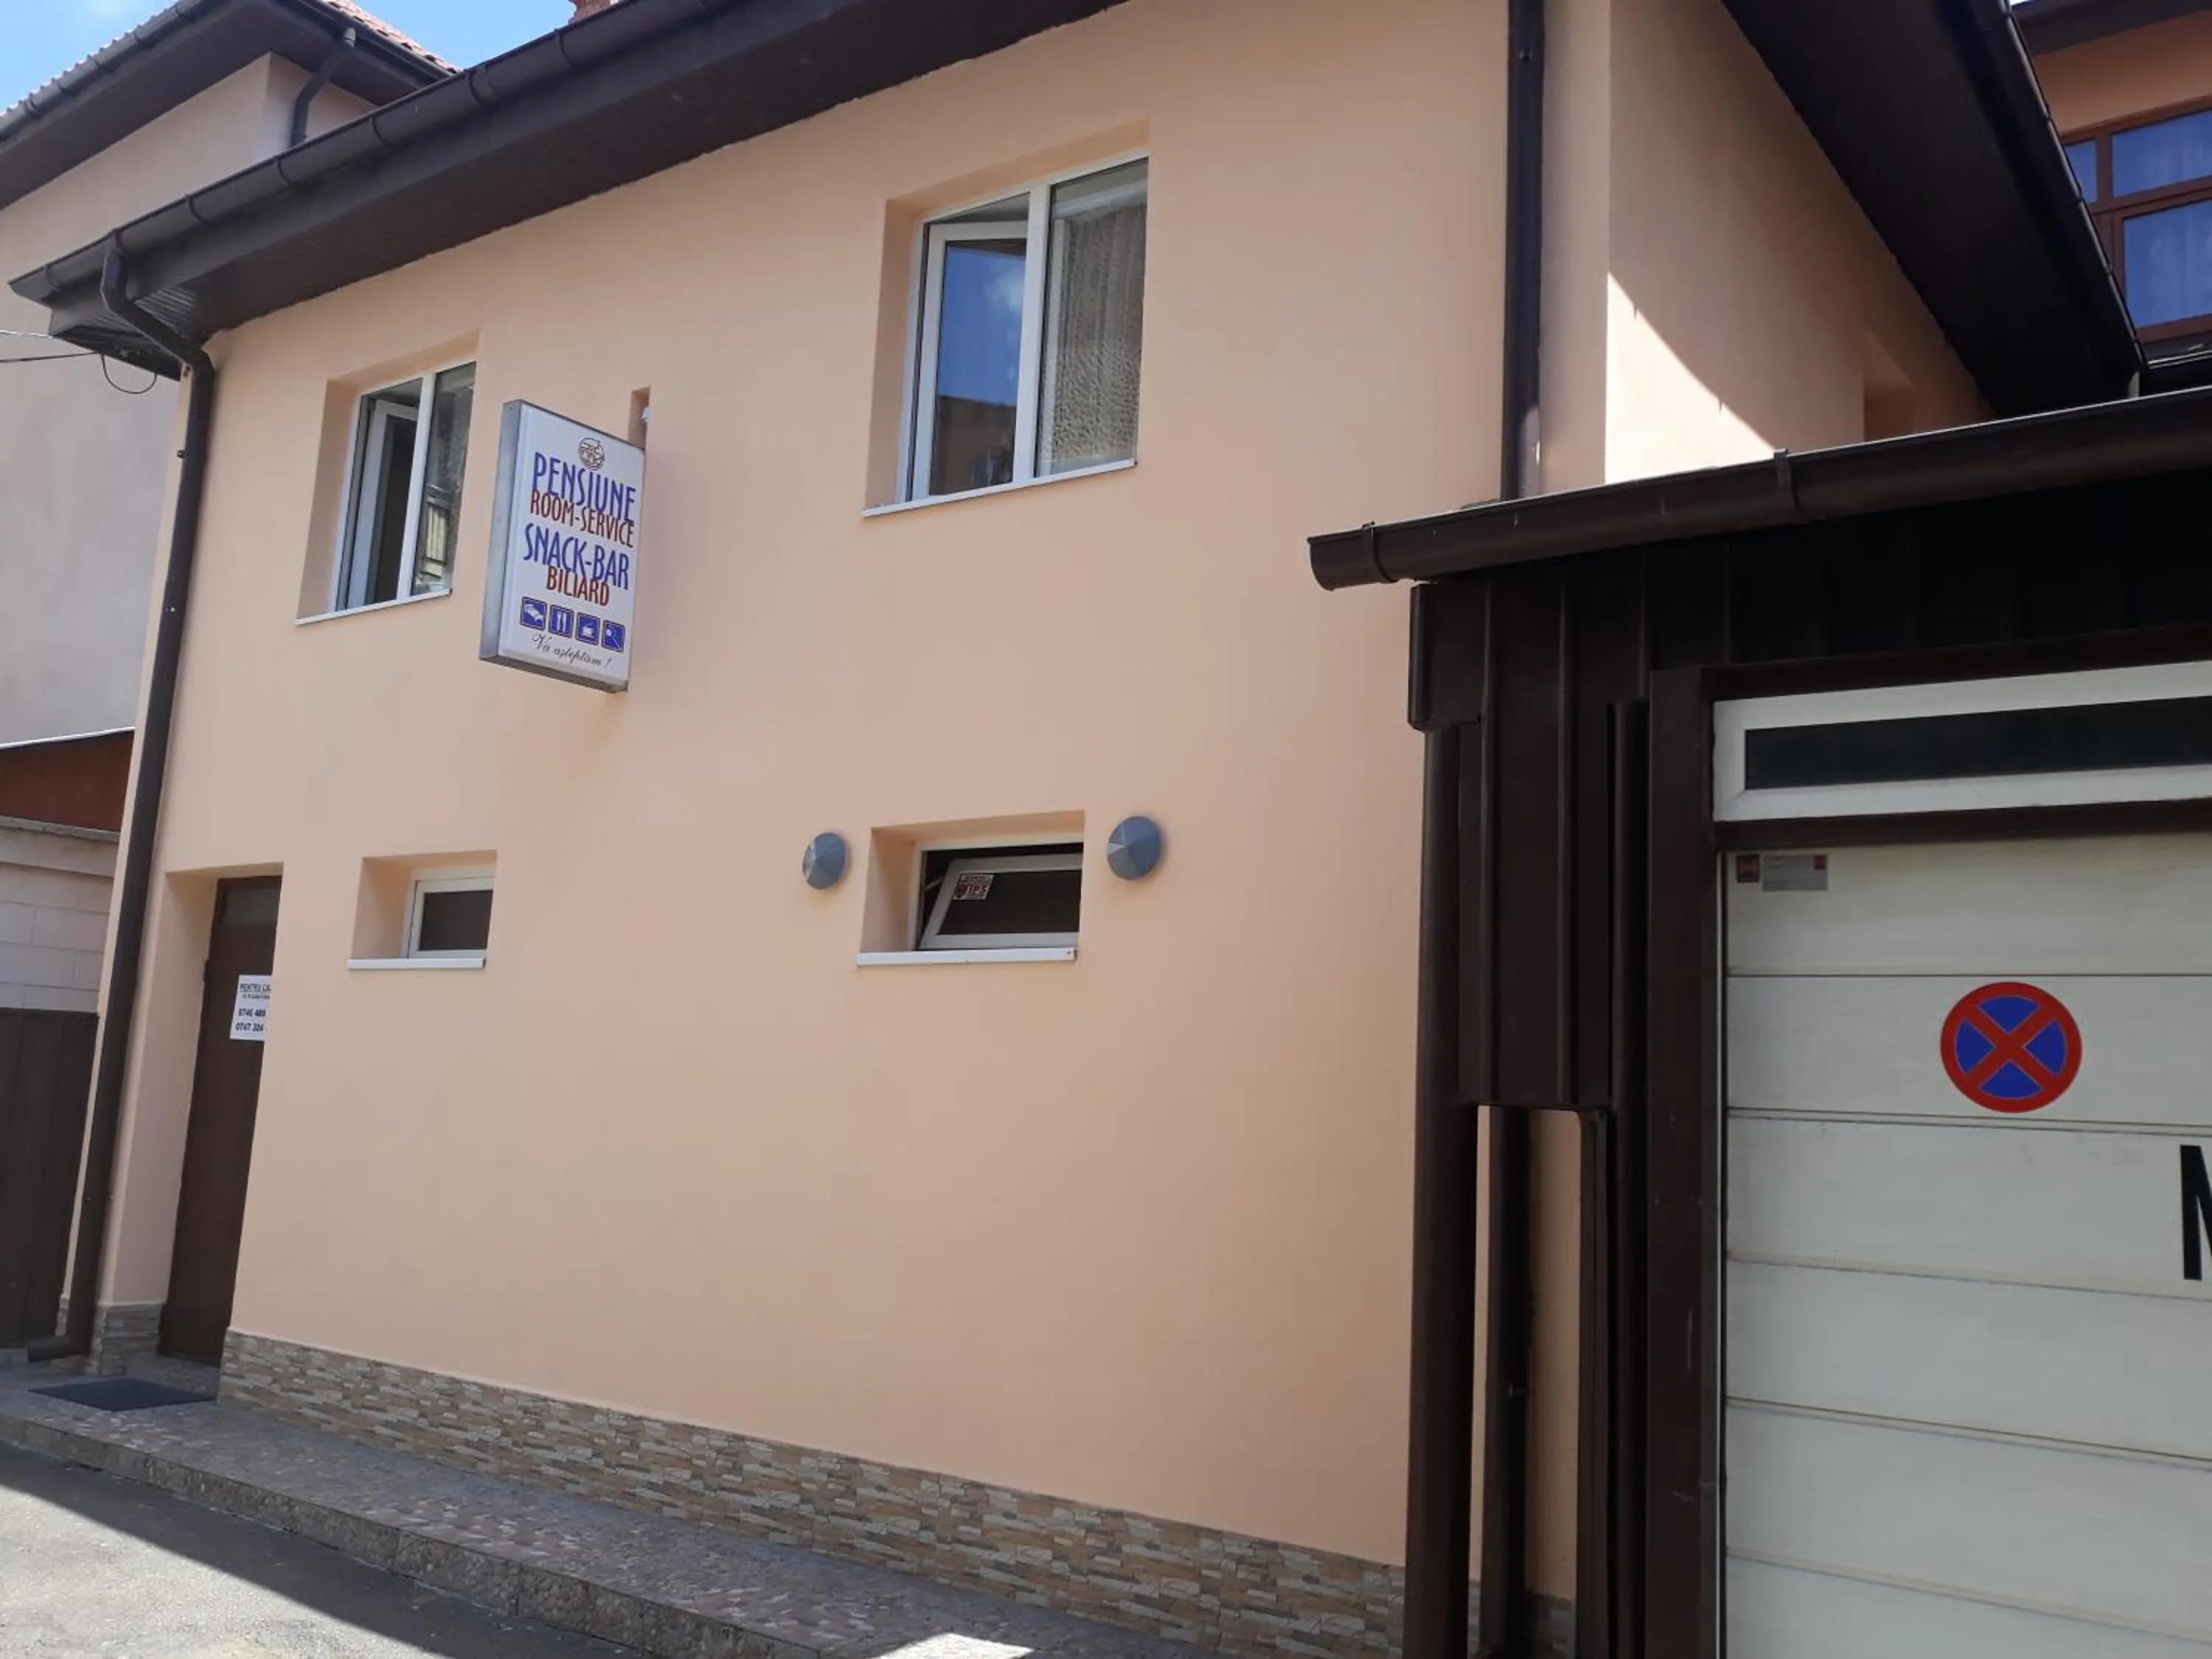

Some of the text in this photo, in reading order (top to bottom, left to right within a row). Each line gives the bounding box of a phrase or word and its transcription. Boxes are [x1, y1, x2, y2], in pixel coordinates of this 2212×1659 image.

[530, 489, 634, 549] ROOM-SERVICE
[532, 451, 636, 524] PENSIUNE
[523, 523, 630, 590] SNACK-BAR
[546, 566, 610, 607] BILIARD
